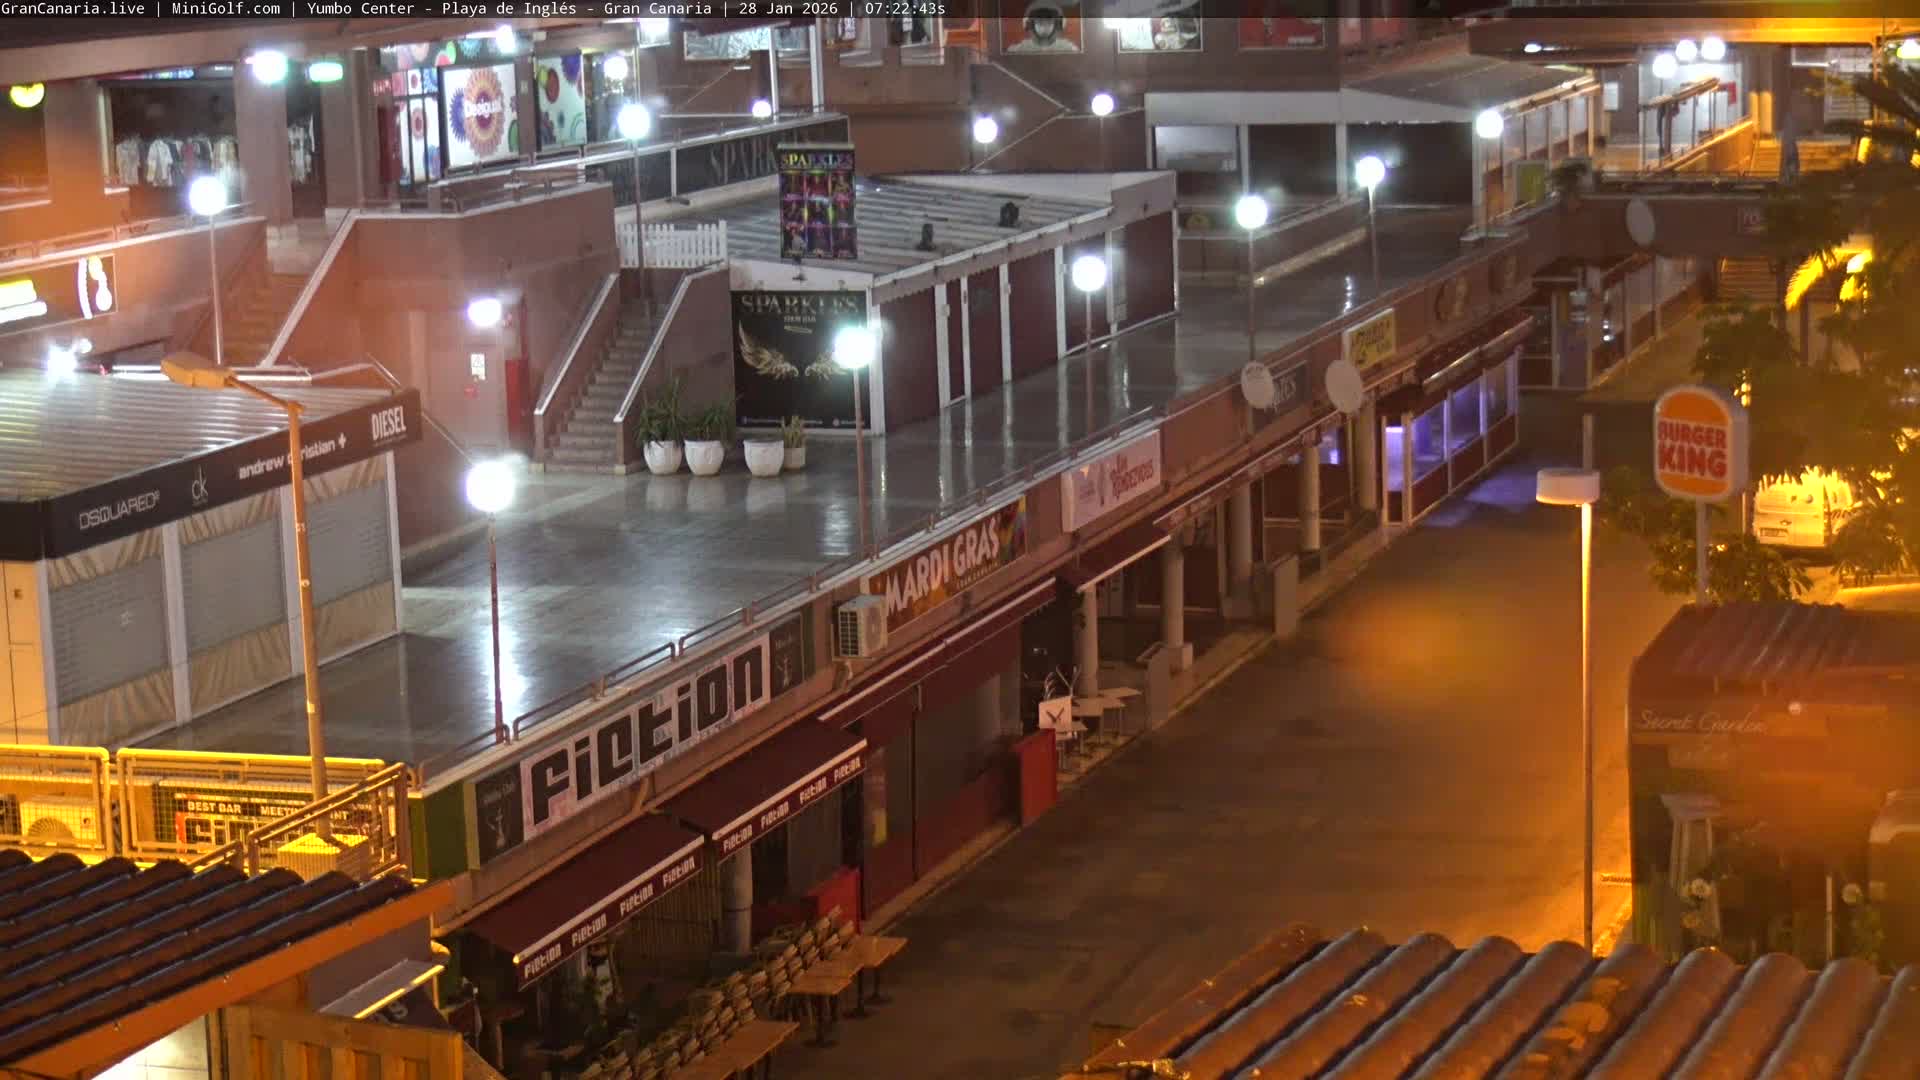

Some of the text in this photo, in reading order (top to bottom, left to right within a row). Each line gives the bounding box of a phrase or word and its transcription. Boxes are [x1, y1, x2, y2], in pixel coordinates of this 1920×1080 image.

[741, 294, 858, 314] SPARKLES
[371, 405, 406, 441] DIESEL
[1658, 421, 1726, 449] BURGER
[238, 437, 336, 480] andrew cristian
[1658, 443, 1727, 480] KING
[886, 543, 949, 615] MARDI
[952, 515, 1001, 577] GRAS
[1640, 704, 1768, 738] Secret Garden
[187, 801, 215, 811] BEST
[218, 802, 241, 813] BAR
